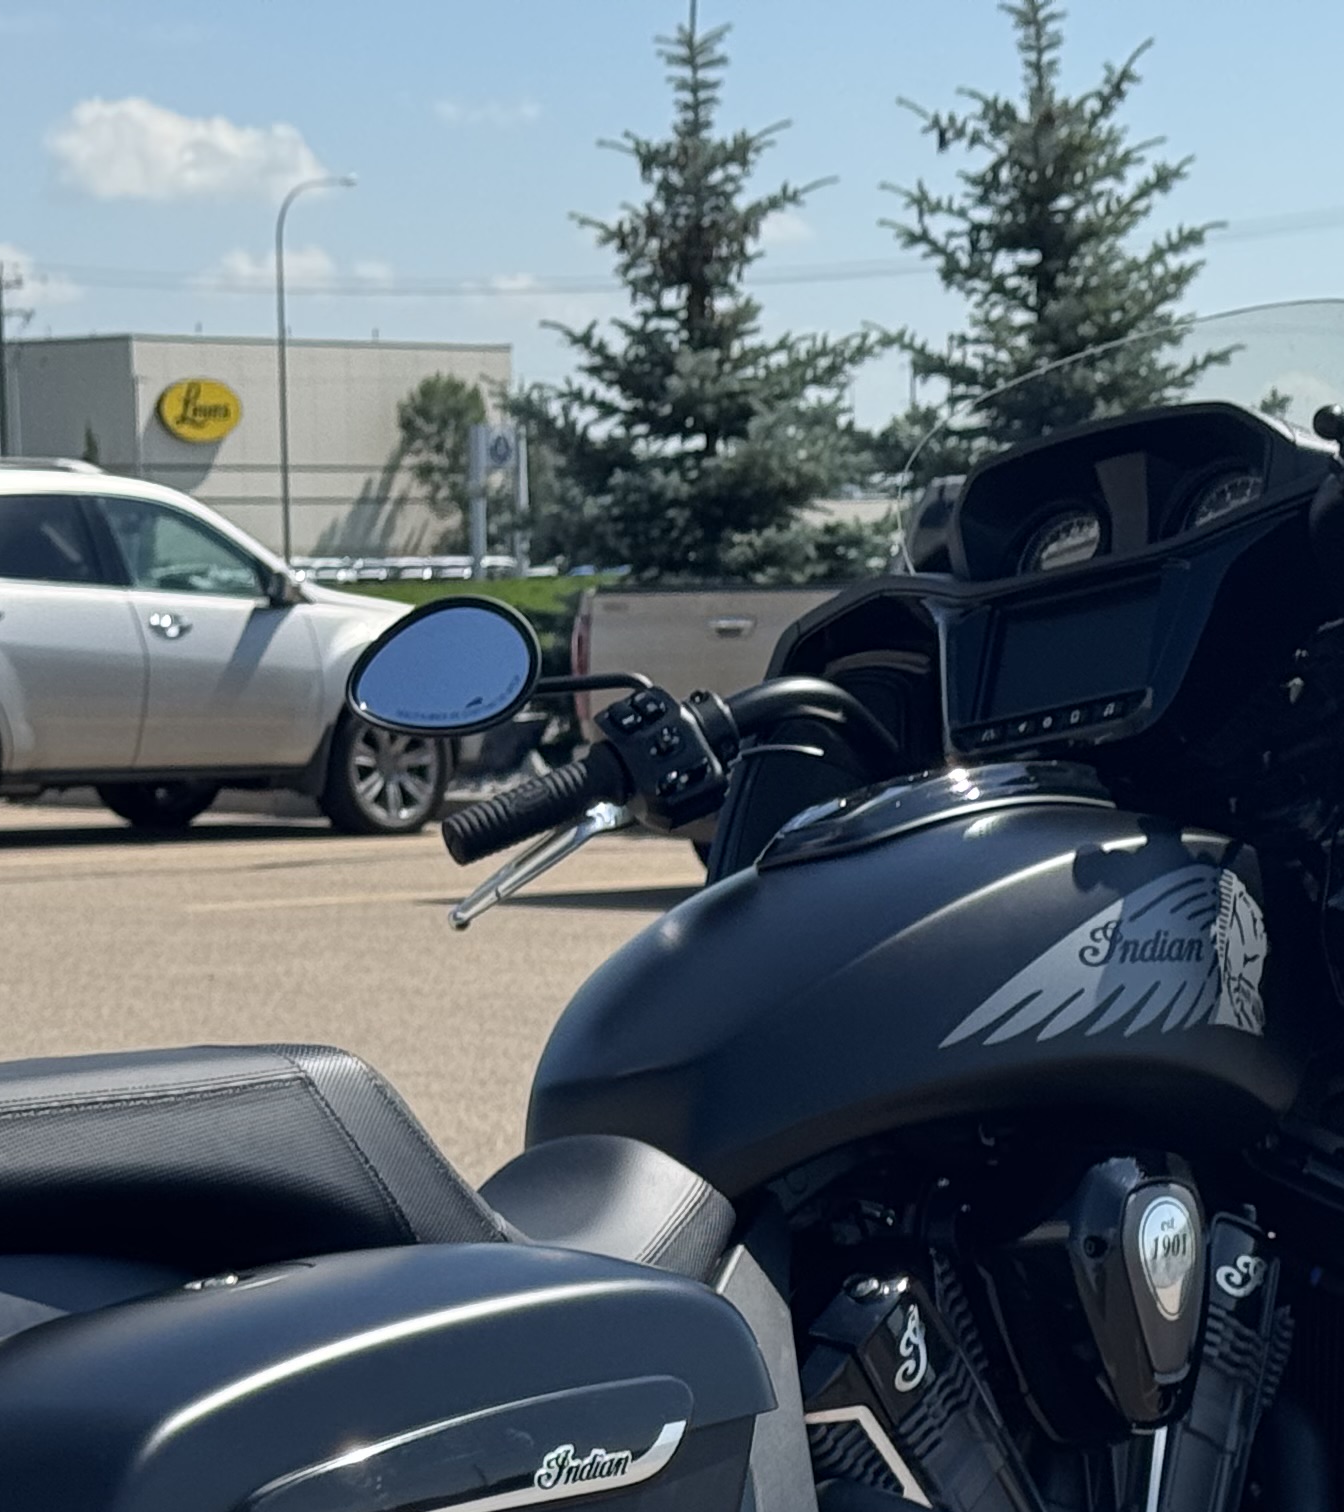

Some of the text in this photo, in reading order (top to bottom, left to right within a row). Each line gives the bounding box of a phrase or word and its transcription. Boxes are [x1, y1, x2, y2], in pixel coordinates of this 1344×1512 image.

[1078, 919, 1204, 967] Indian
[1152, 1233, 1187, 1260] 1901
[536, 1446, 631, 1490] Indian
